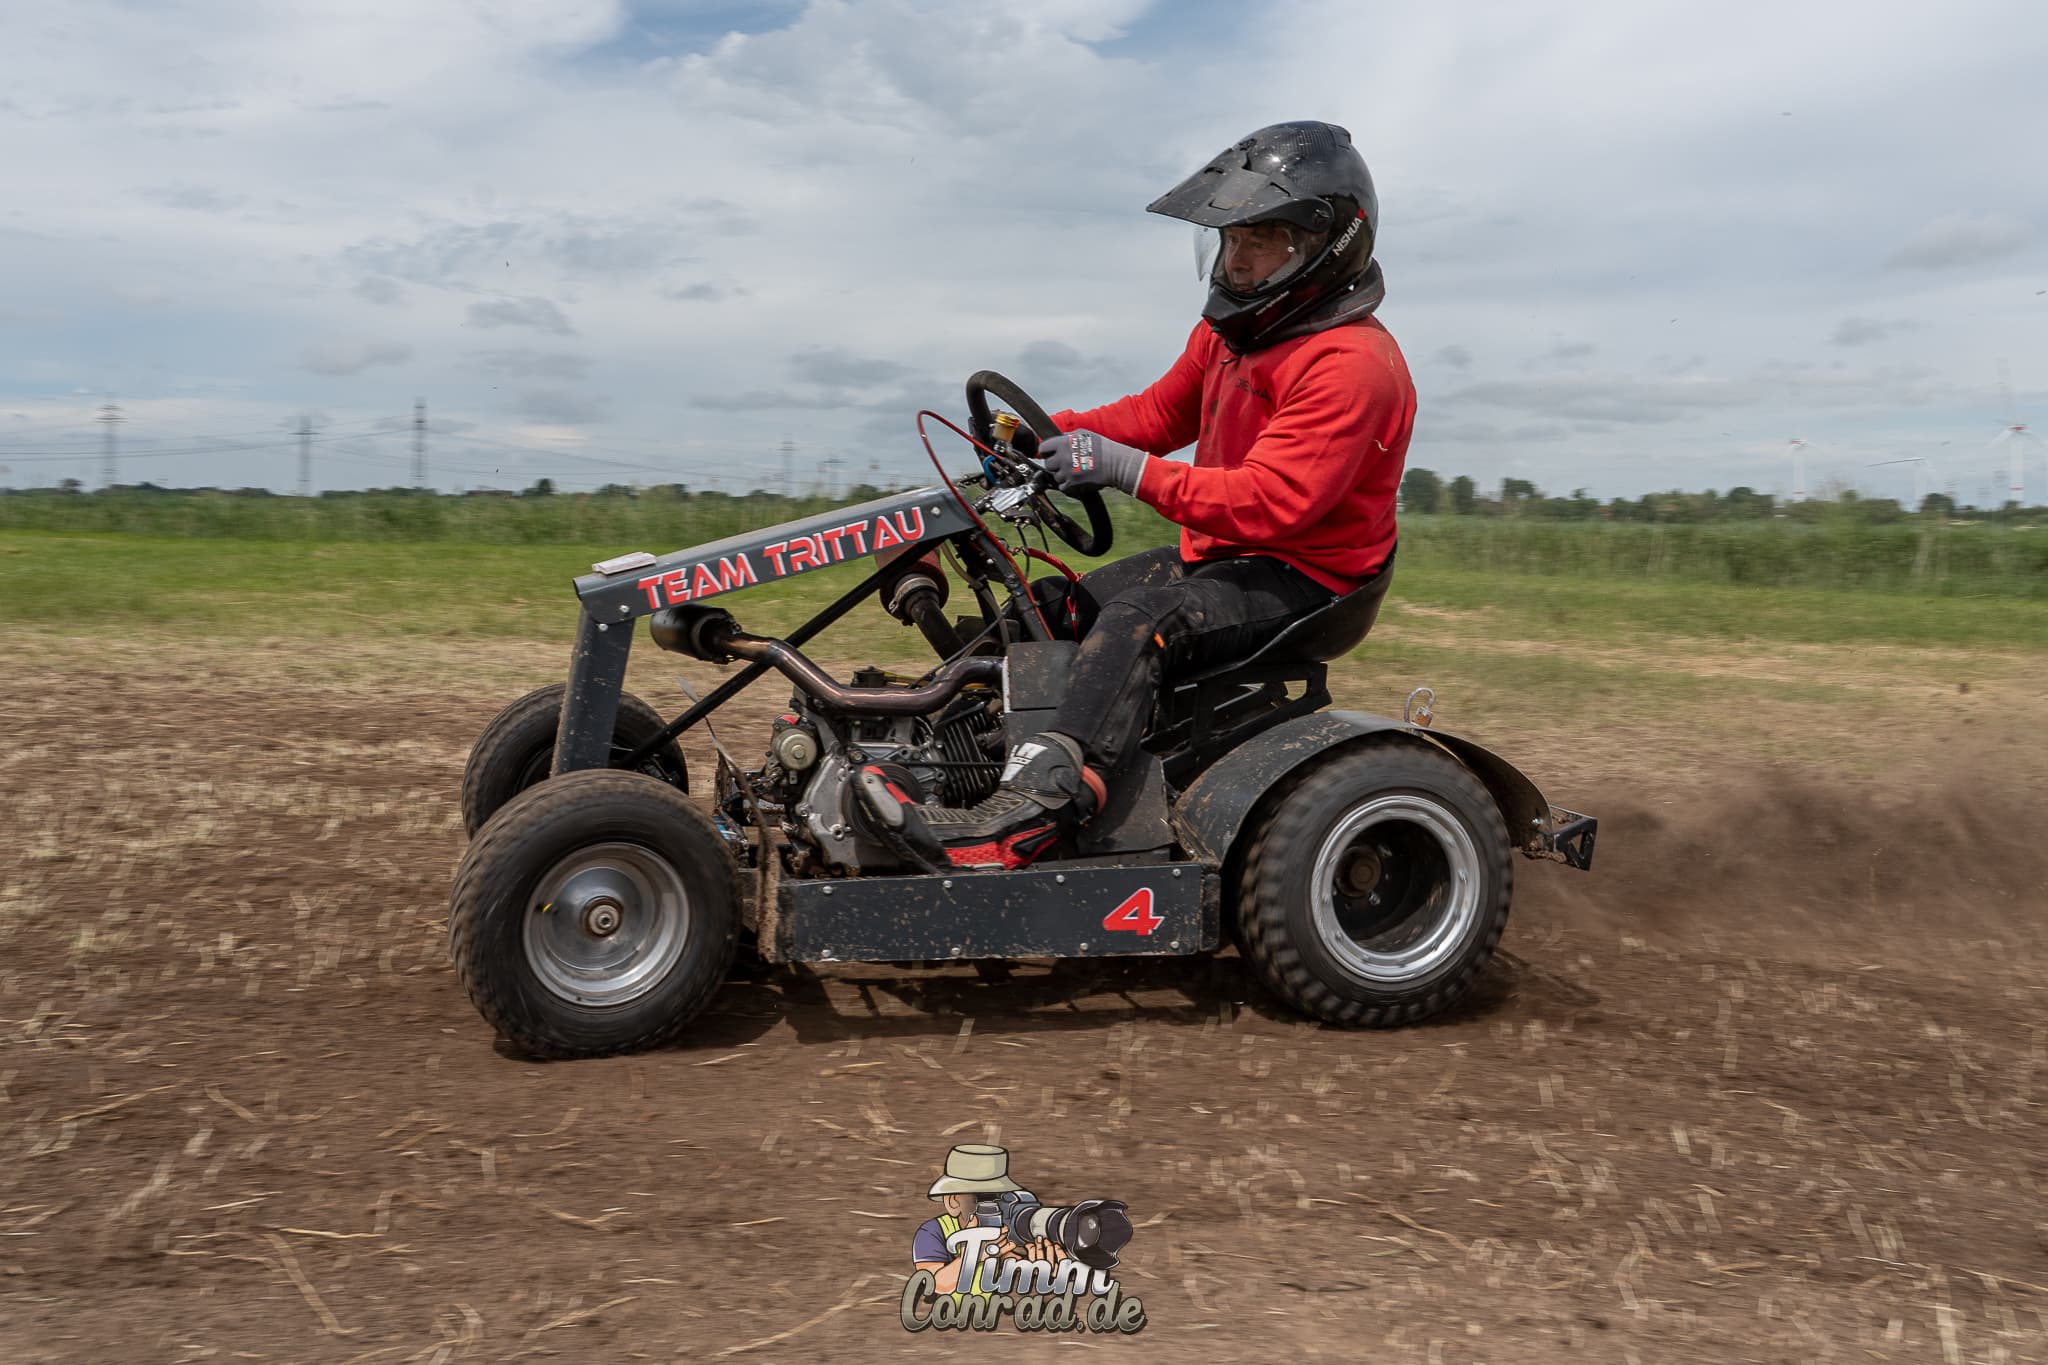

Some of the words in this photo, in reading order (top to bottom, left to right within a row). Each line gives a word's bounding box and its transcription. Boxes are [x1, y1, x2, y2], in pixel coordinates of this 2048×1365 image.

[1332, 216, 1364, 256] NISHUA
[637, 552, 758, 609] TEAM
[763, 506, 926, 577] TRITTAU
[1102, 887, 1165, 936] 4
